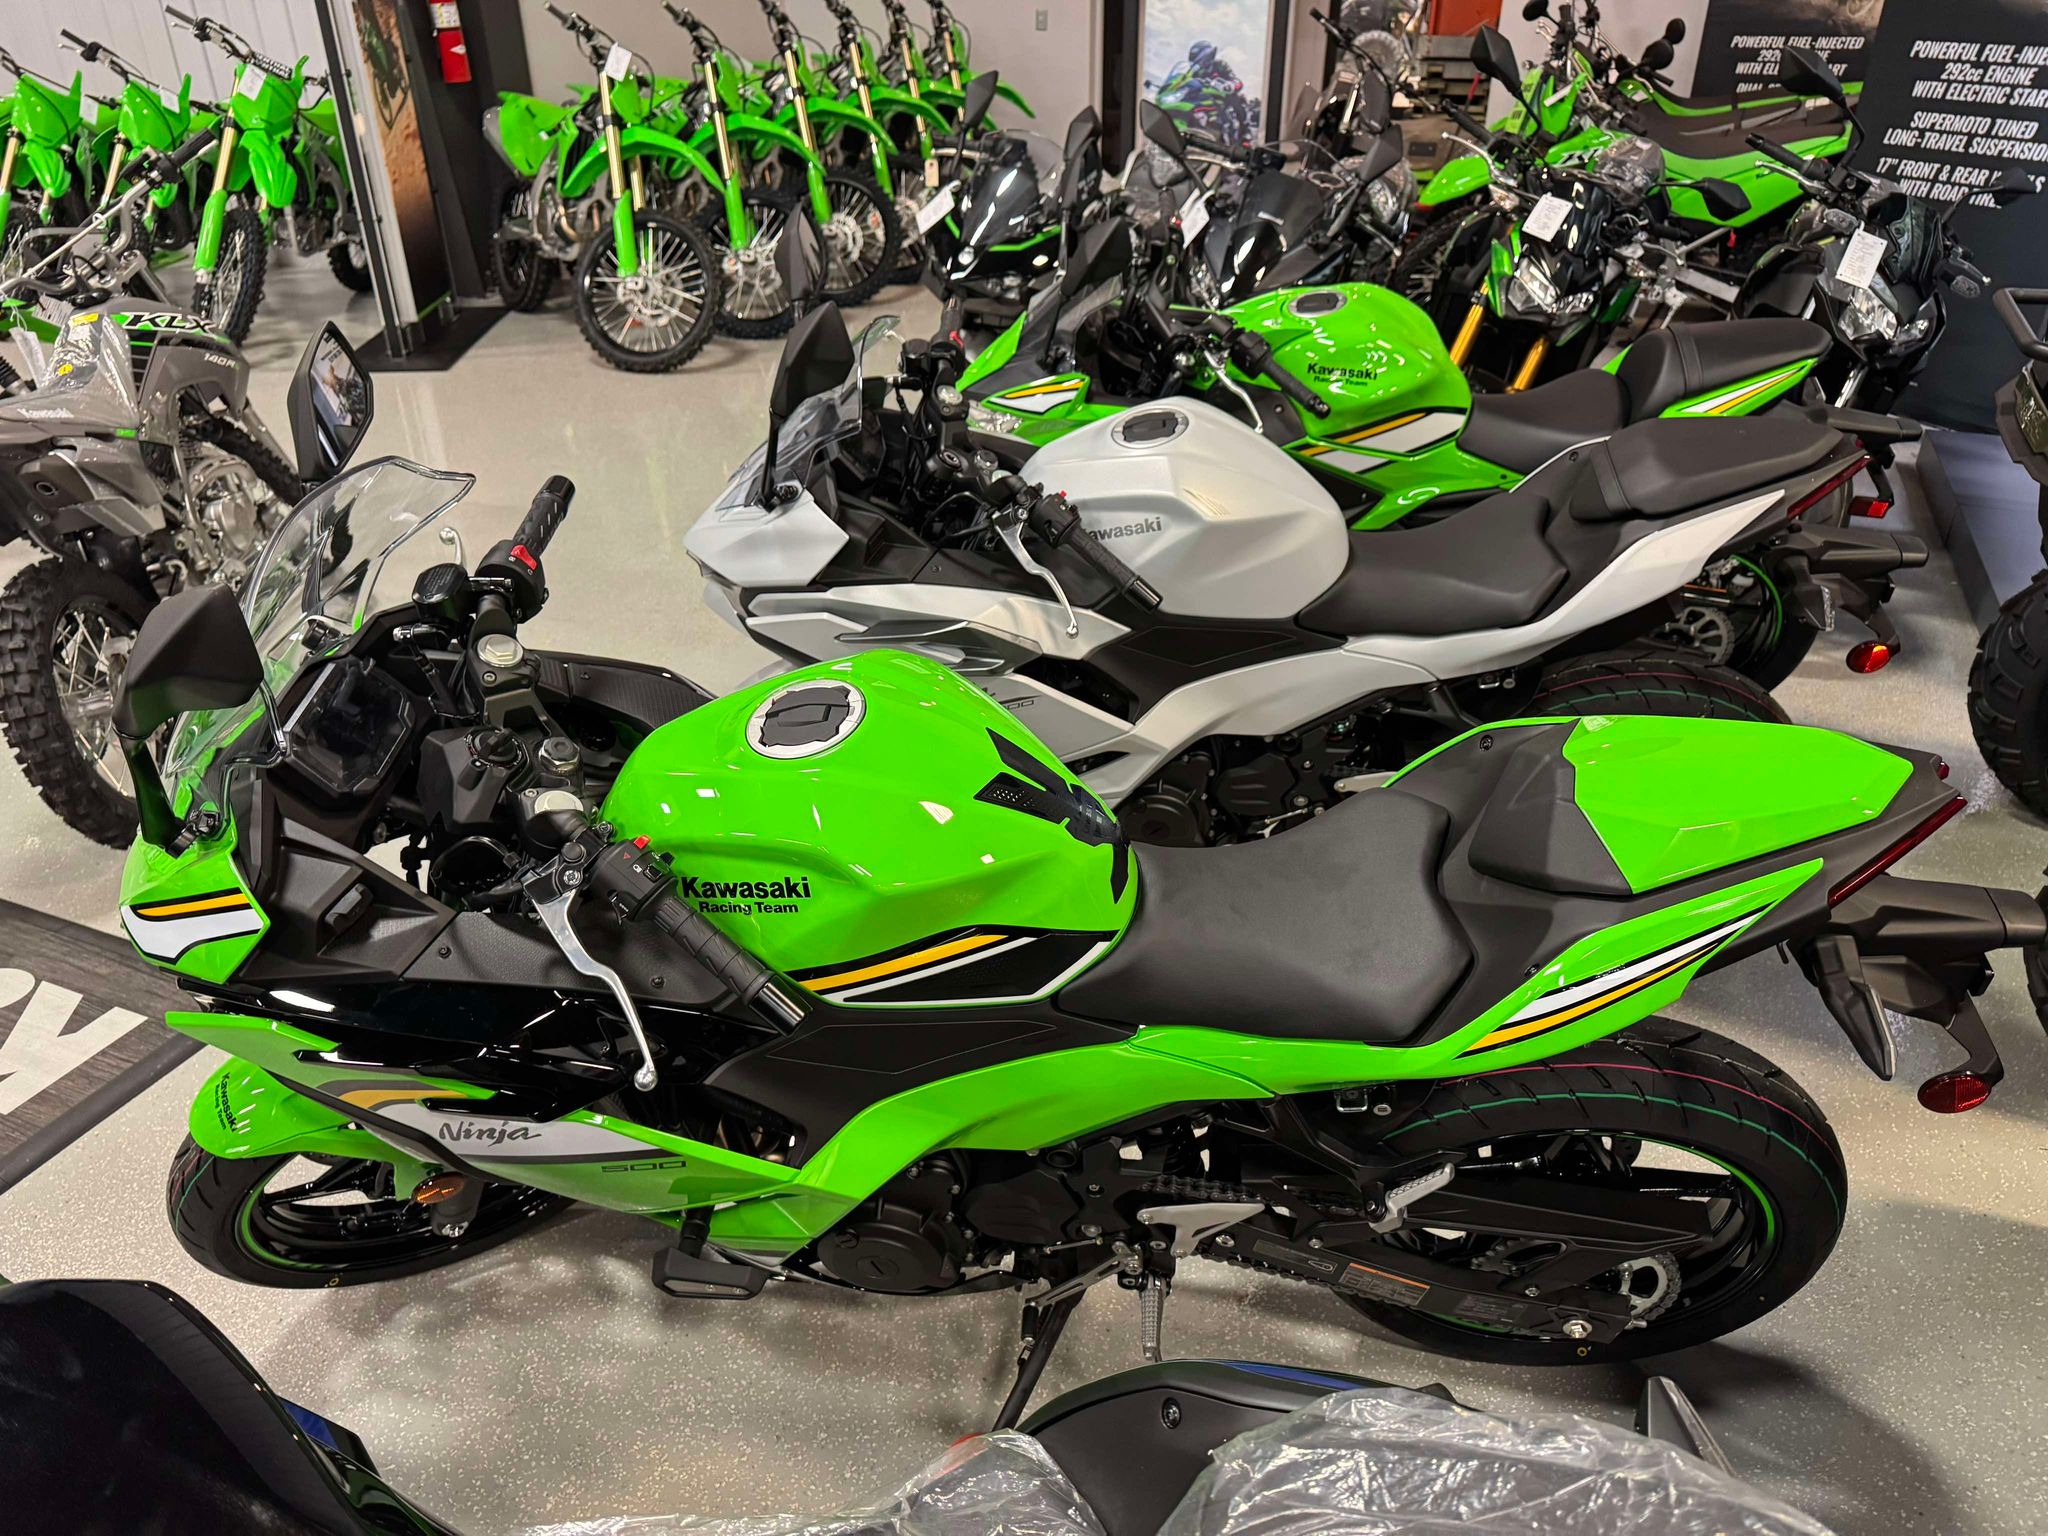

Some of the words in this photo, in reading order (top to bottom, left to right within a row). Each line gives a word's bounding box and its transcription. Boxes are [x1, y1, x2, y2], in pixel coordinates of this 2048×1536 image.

[1730, 35, 1786, 48] POWERFUL
[1787, 36, 1865, 49] FUEL-INJECTED
[1910, 40, 1981, 61] POWERFUL
[1735, 62, 1762, 75] WITH
[1940, 62, 1984, 82] 292cc
[1983, 65, 2039, 86] ENGINE
[1911, 80, 1948, 99] WITH
[1945, 83, 2011, 104] ELECTRIC
[1910, 111, 1992, 135] SUPERMOTO
[1991, 118, 2039, 140] TUNED
[1883, 128, 1968, 153] LONG-TRAVEL
[1896, 159, 1941, 181] FRONT
[1938, 164, 1952, 181] &
[1950, 166, 1990, 187] REAR
[1899, 178, 1931, 198] WITH
[122, 311, 217, 334] KLX
[1087, 516, 1163, 541] awasaki
[681, 876, 812, 899] Kawasaki
[699, 902, 752, 915] Racing
[754, 901, 799, 913] Team
[221, 1071, 238, 1132] Kawasaki
[217, 1108, 227, 1130] Team
[438, 1121, 542, 1147] Ninja
[601, 1160, 687, 1173] 500
